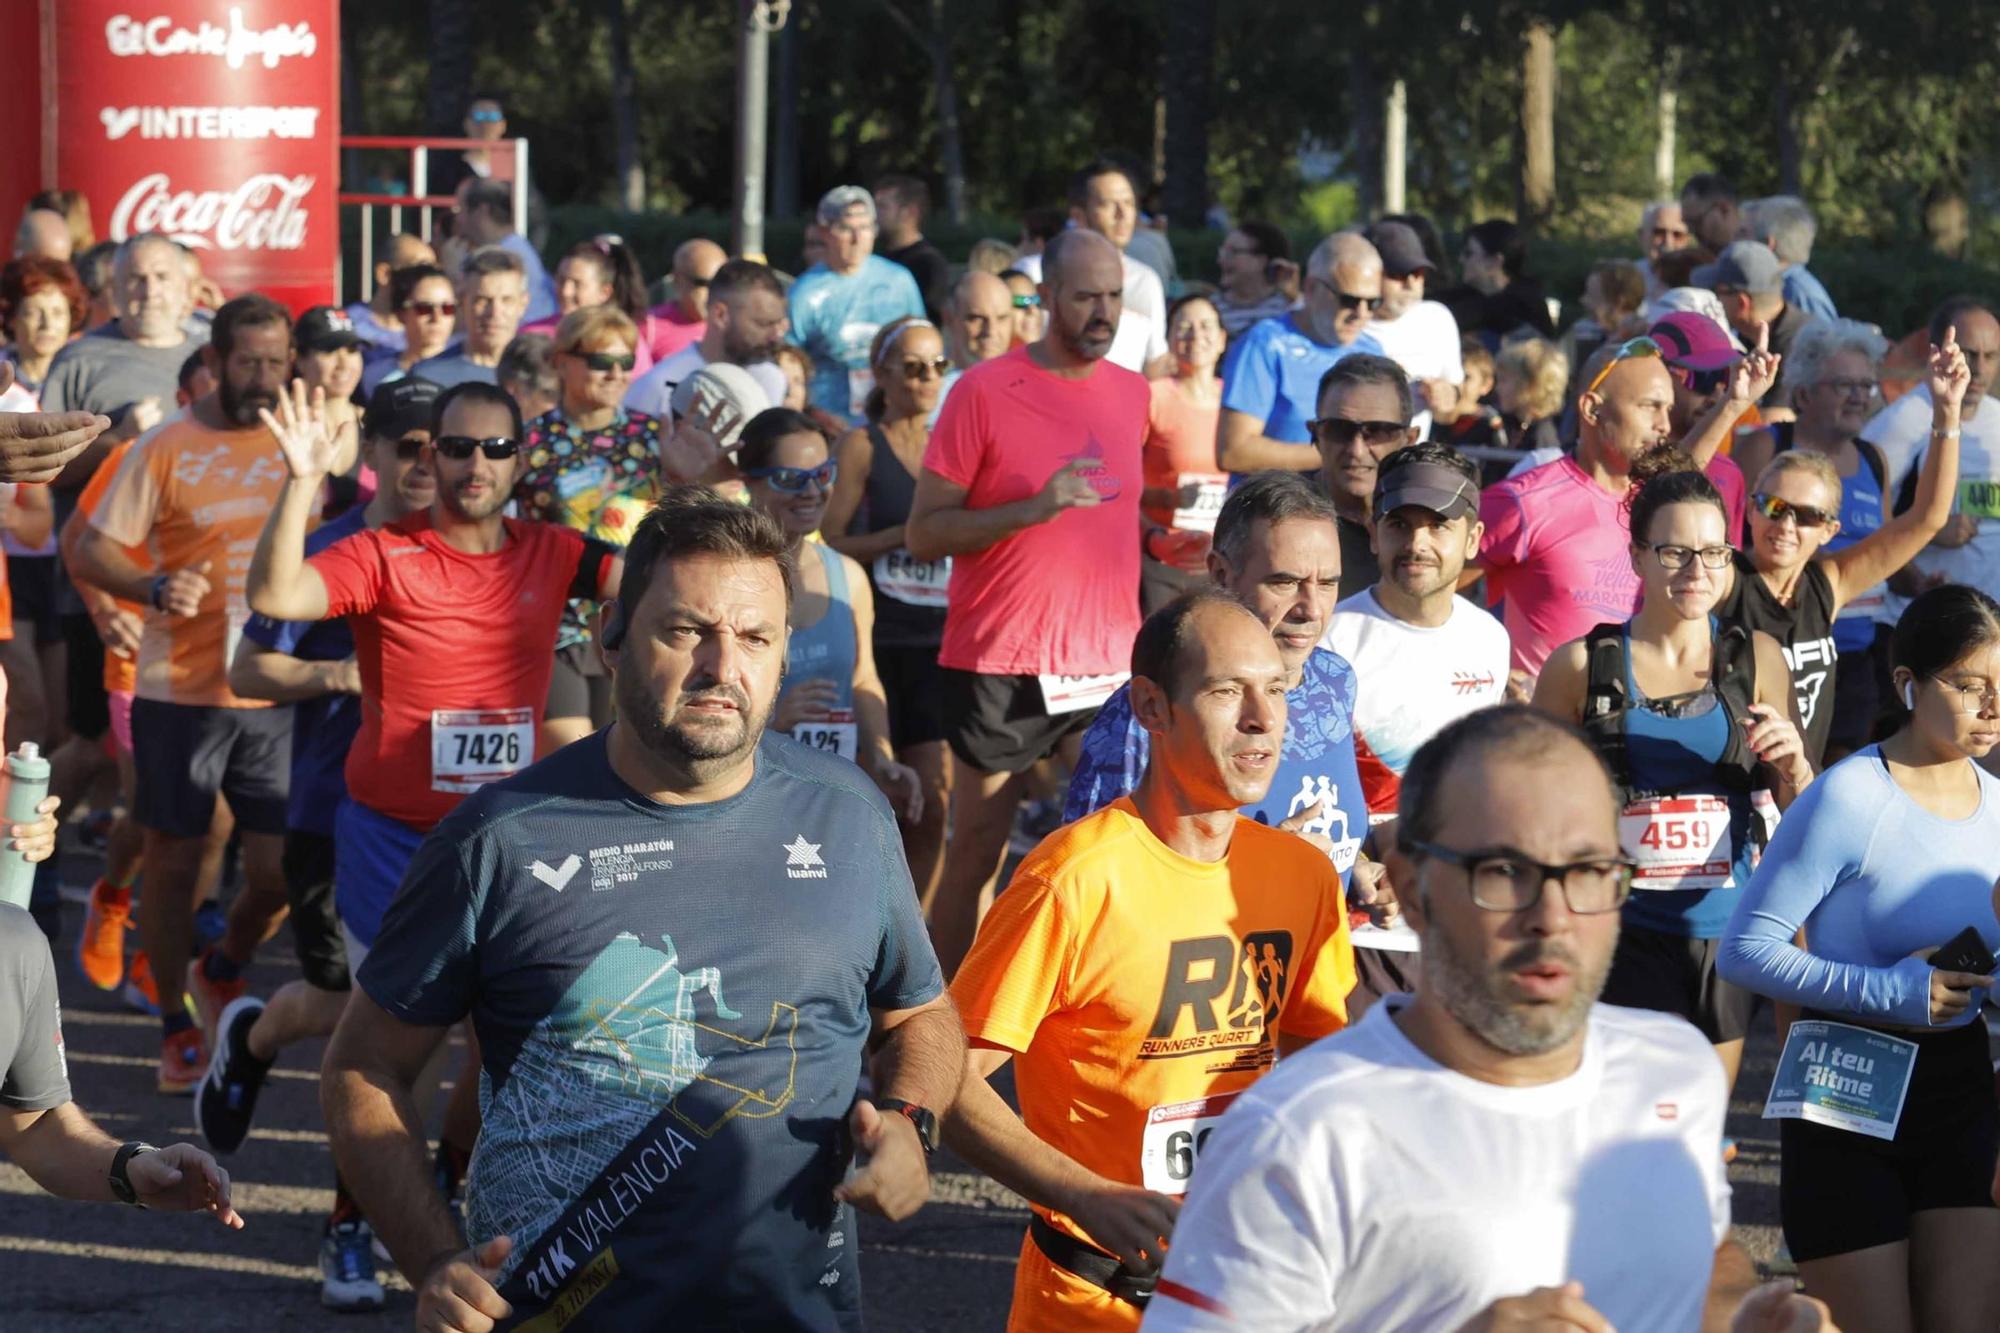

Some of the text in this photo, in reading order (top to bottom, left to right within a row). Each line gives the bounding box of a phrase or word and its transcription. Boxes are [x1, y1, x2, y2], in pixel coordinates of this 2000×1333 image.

[453, 732, 520, 765] 7426
[1640, 820, 1720, 850] 459
[589, 838, 674, 859] MEDIO MARATÓN
[616, 872, 639, 882] 2017
[632, 860, 673, 873] ALFONSO
[787, 867, 828, 878] luanvi
[1139, 1030, 1254, 1053] RUNNERS QUART
[1798, 1040, 1829, 1064] Al
[1831, 1046, 1875, 1075] teu
[1804, 1063, 1873, 1098] Ritme
[526, 1126, 698, 1300] 21K VALÈNCIA
